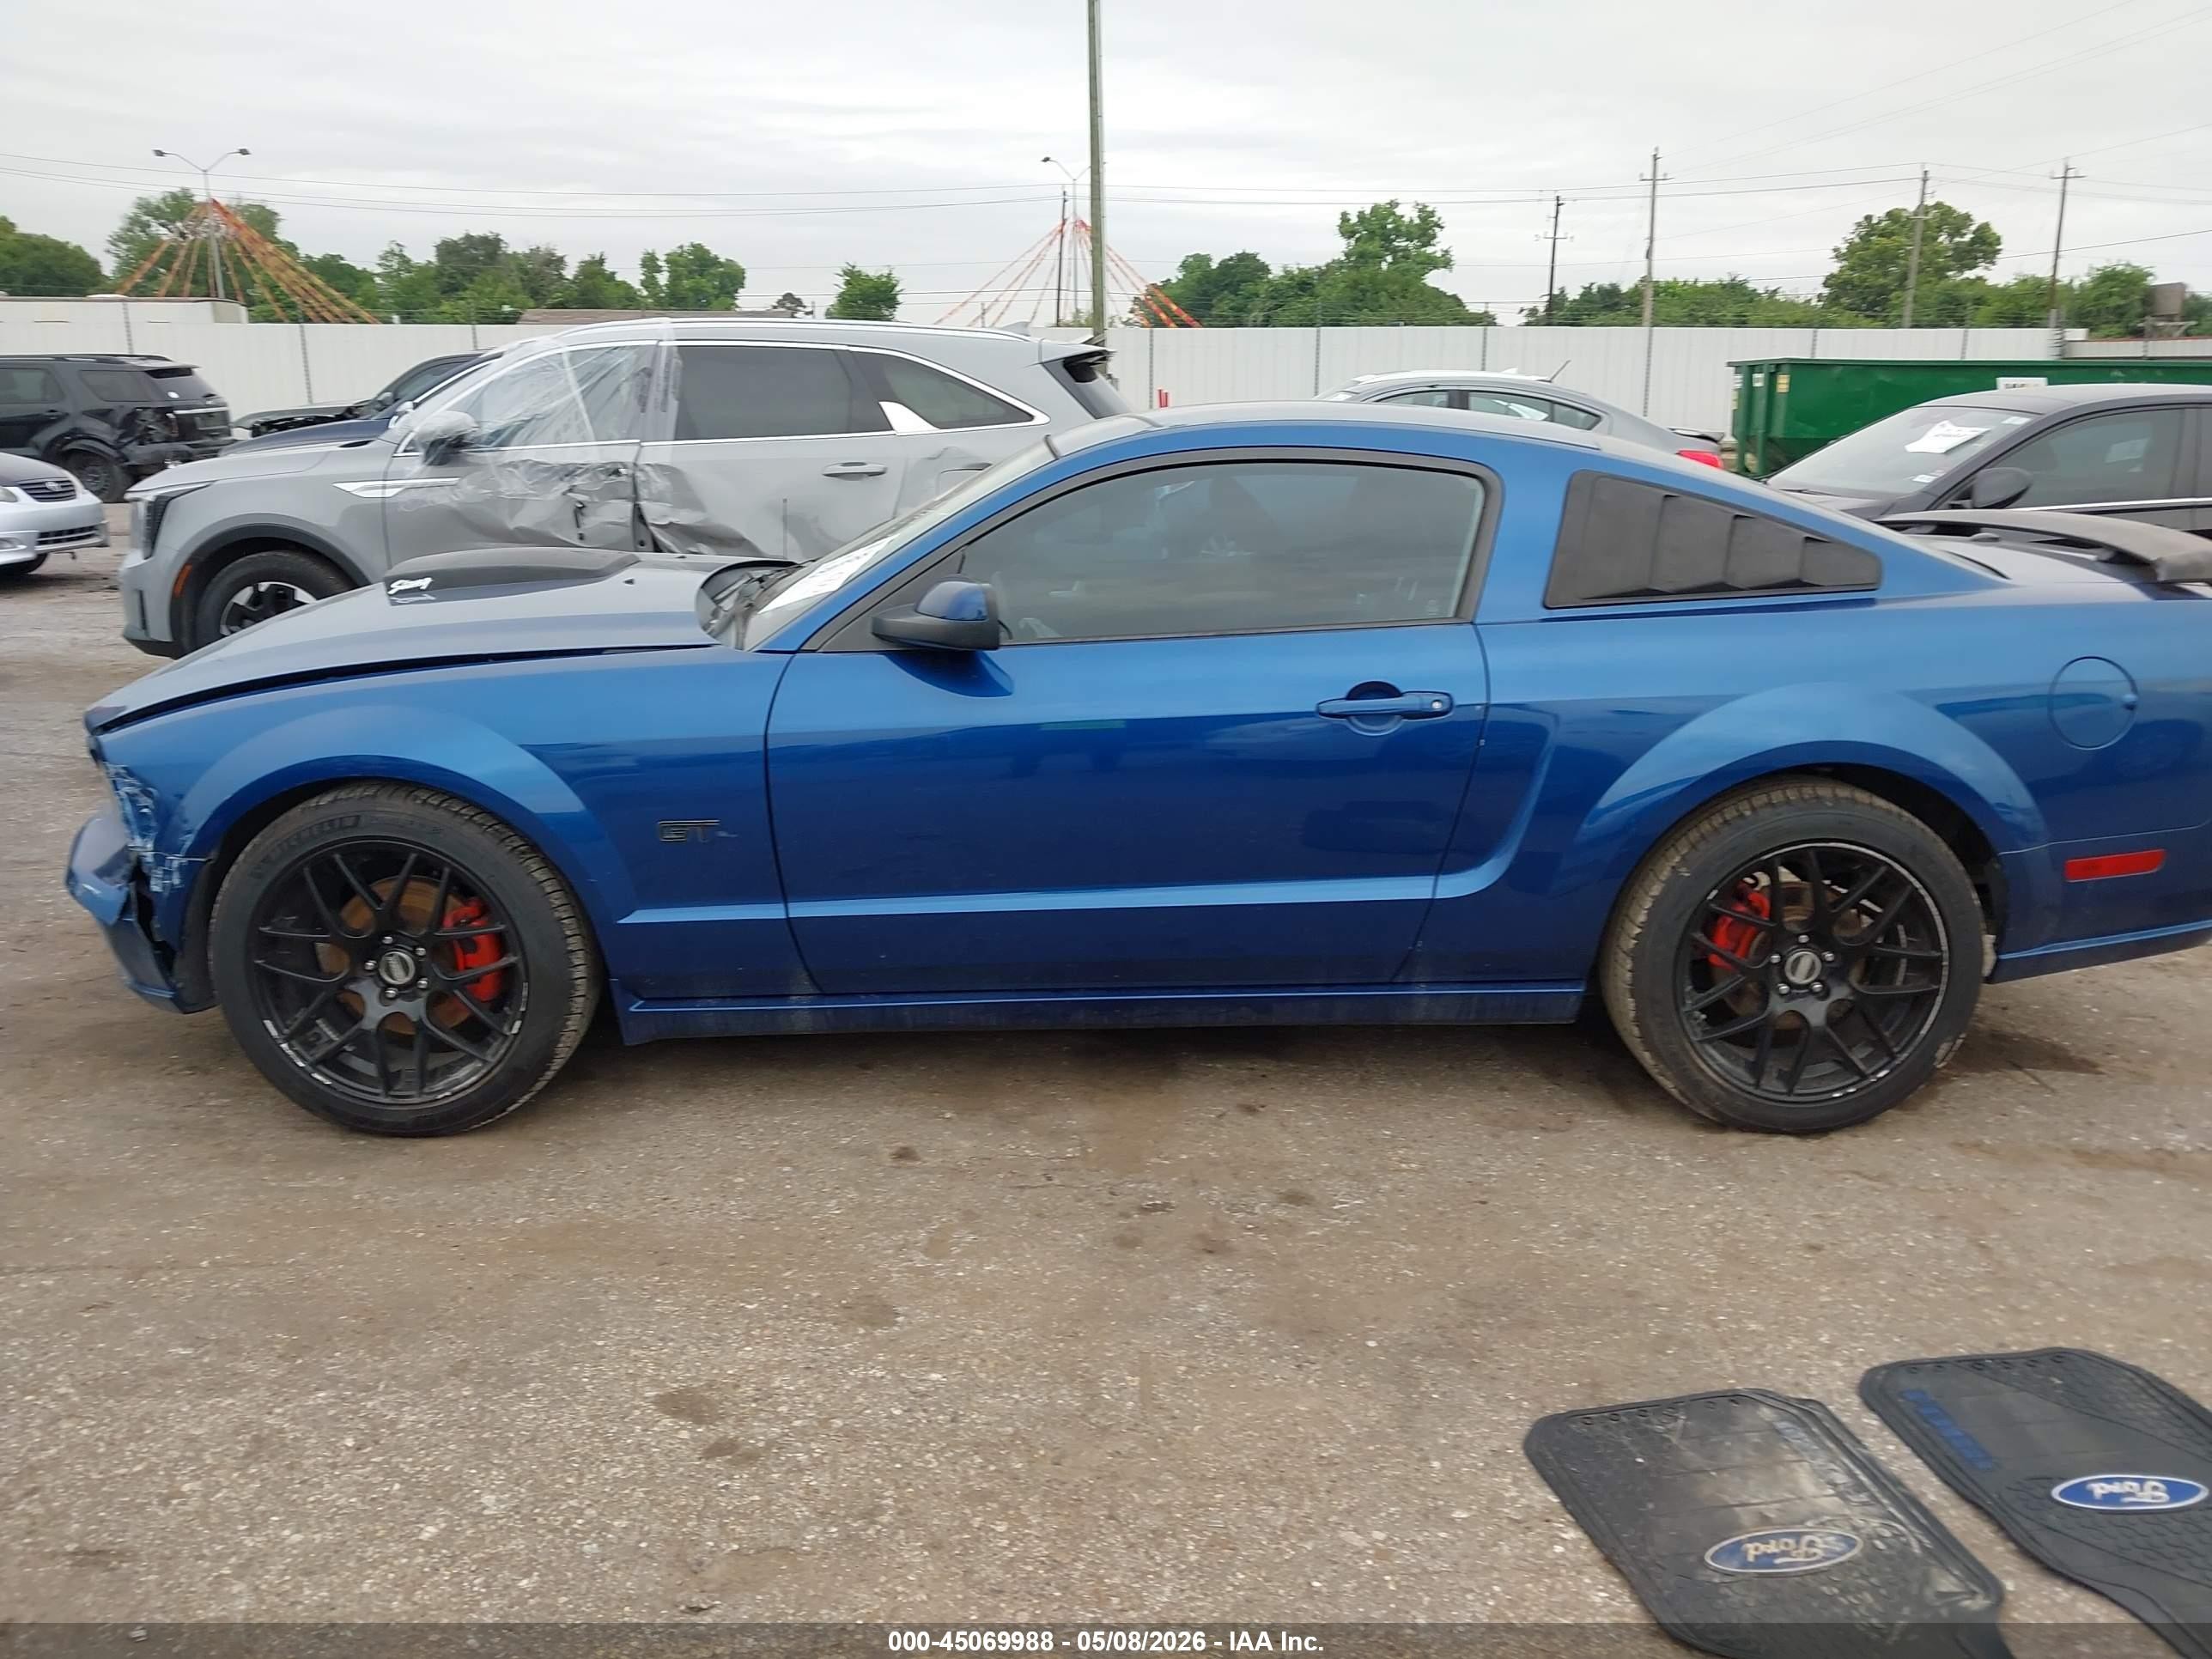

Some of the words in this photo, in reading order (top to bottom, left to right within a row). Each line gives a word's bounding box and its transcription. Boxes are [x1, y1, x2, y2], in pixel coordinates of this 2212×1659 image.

[658, 819, 720, 842] GT
[2086, 1480, 2171, 1503] Ford
[1741, 1534, 1825, 1563] Ford
